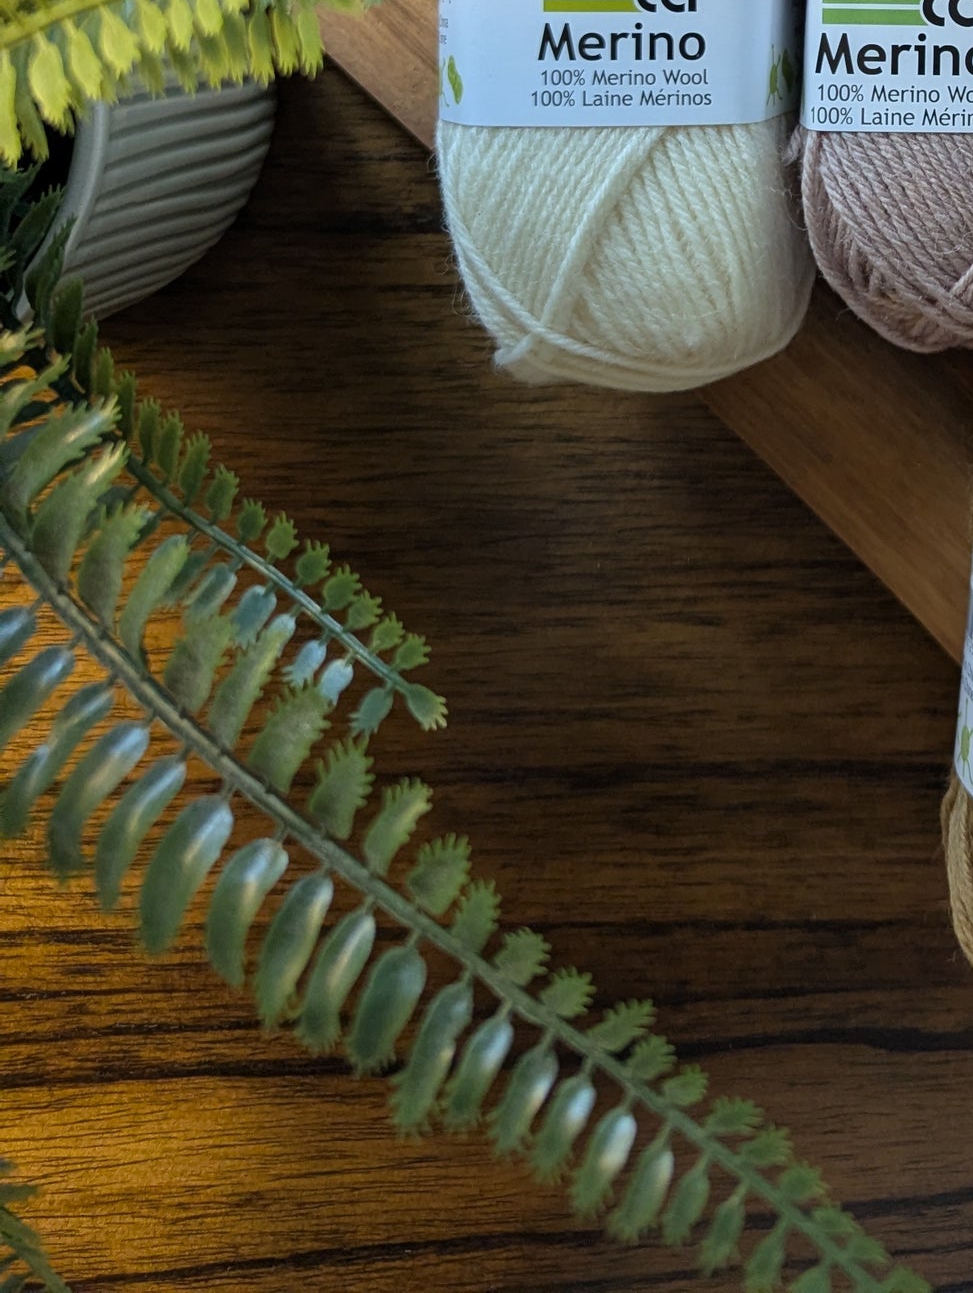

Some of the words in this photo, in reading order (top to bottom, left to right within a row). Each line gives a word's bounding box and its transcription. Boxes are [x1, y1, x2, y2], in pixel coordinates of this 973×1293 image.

[538, 22, 706, 61] Merino
[541, 69, 586, 85] 100%
[592, 69, 656, 85] Merino
[662, 69, 708, 85] Wool
[531, 90, 575, 106] 100%
[582, 90, 633, 106] Laine
[640, 90, 712, 106] Mérinos
[817, 84, 864, 102] 100%
[871, 84, 941, 102] Merino
[811, 107, 853, 125] 100%
[861, 107, 915, 125] Laine
